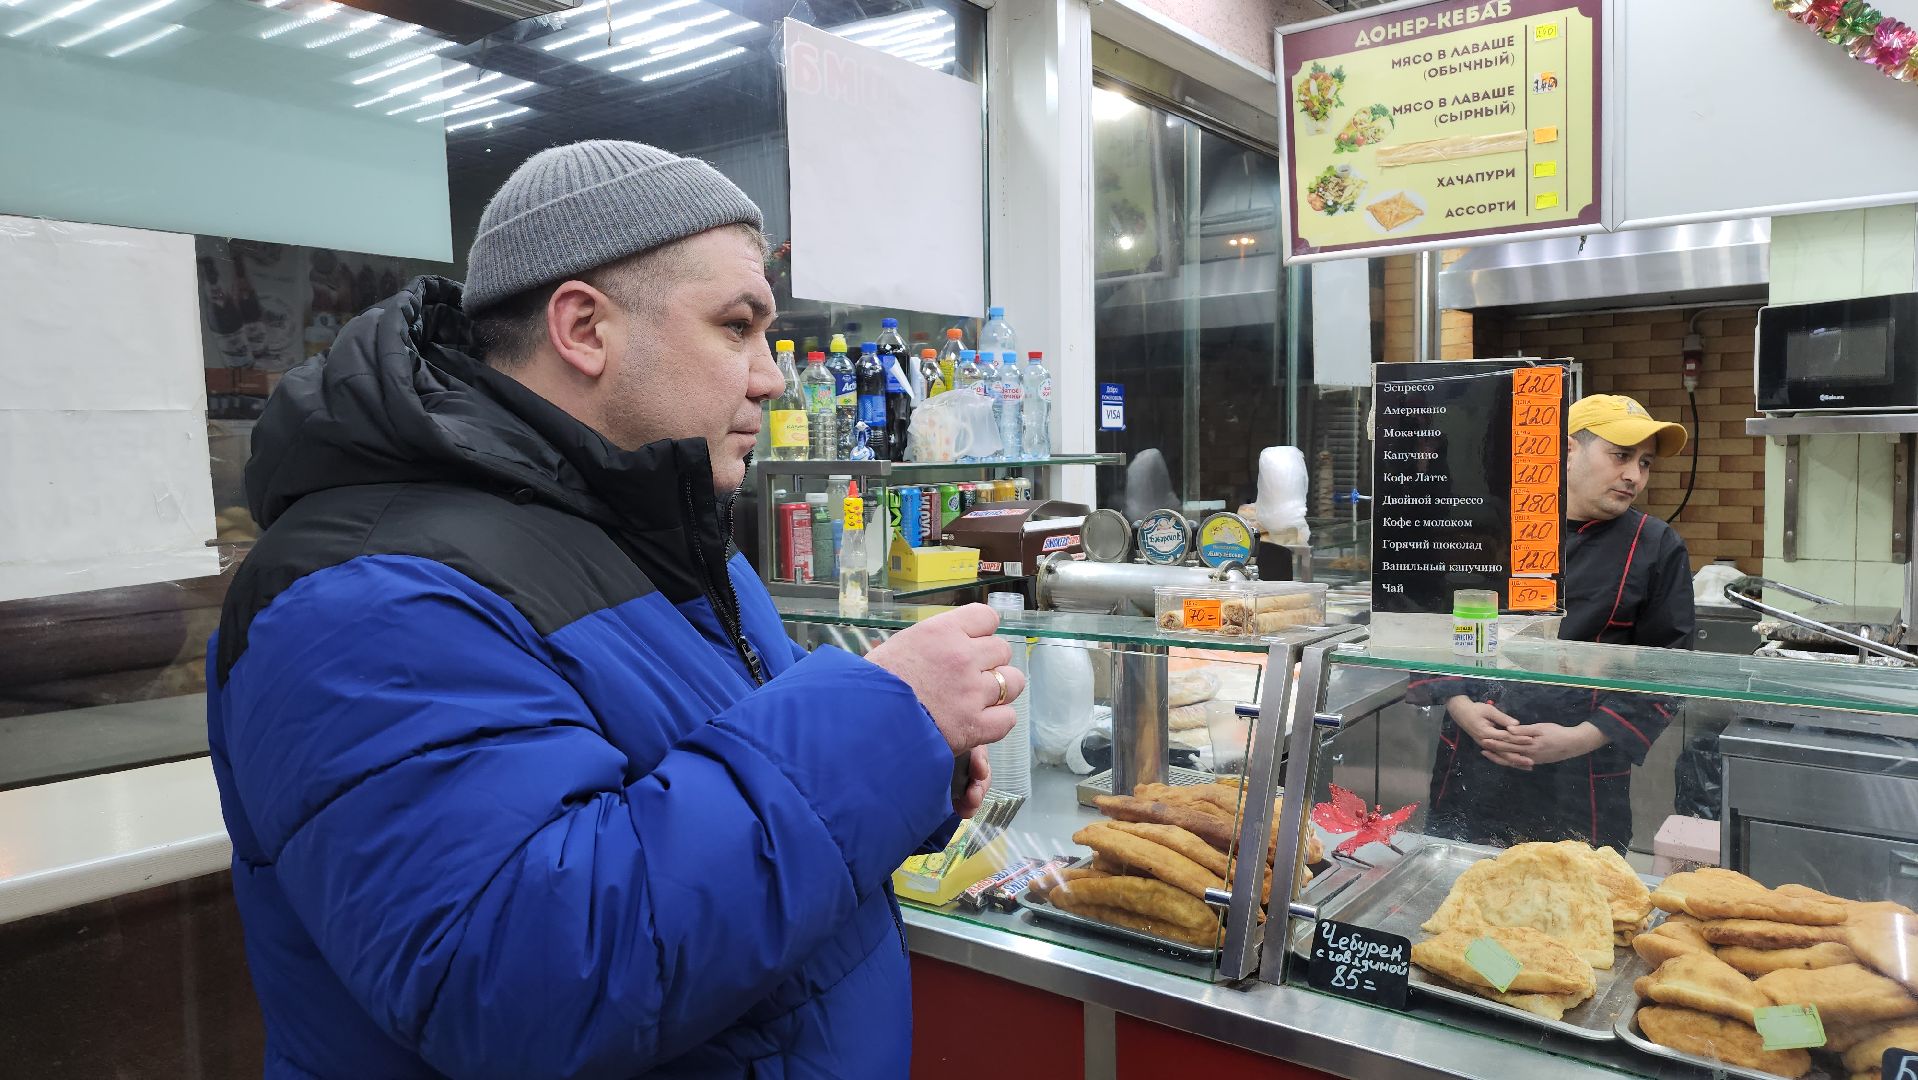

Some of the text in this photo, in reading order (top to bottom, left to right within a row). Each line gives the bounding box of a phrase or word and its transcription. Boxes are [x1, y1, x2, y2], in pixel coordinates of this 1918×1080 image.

[1354, 0, 1513, 48] ДОНЕР-КЕБАБ
[1391, 35, 1516, 70] МЯСО В ЛАВАШЕ
[1423, 53, 1516, 80] (ОБЫЧНЫЙ)
[1392, 85, 1516, 117] МЯСО В ЛАВАШЕ
[1433, 100, 1517, 127] (СЫРНЫЙ)
[1436, 167, 1516, 188] ХАЧАПУРИ
[1444, 199, 1517, 219] АССОРТИ
[1383, 383, 1435, 393] Эспрессо
[1516, 374, 1556, 395] 120
[1106, 409, 1121, 420] VISA
[1383, 406, 1447, 417] Американо
[1519, 406, 1556, 426] 120
[1383, 428, 1442, 438] Мокачино
[1383, 450, 1439, 461] Капучино
[1514, 436, 1551, 456] 120
[1383, 473, 1448, 484] Кофе Латте
[1515, 464, 1553, 483] 120
[1382, 495, 1484, 506] Двойной эспрессо
[1515, 493, 1556, 513] 180
[1382, 517, 1473, 528] Кофе с молоком
[1515, 522, 1553, 541] 120
[1382, 540, 1483, 551] Горячий шоколад
[1382, 561, 1503, 574] Ванильный капучино
[1515, 551, 1556, 571] 120
[1382, 583, 1404, 593] Чай
[1321, 921, 1403, 961] Чебурек
[1316, 949, 1325, 958] с
